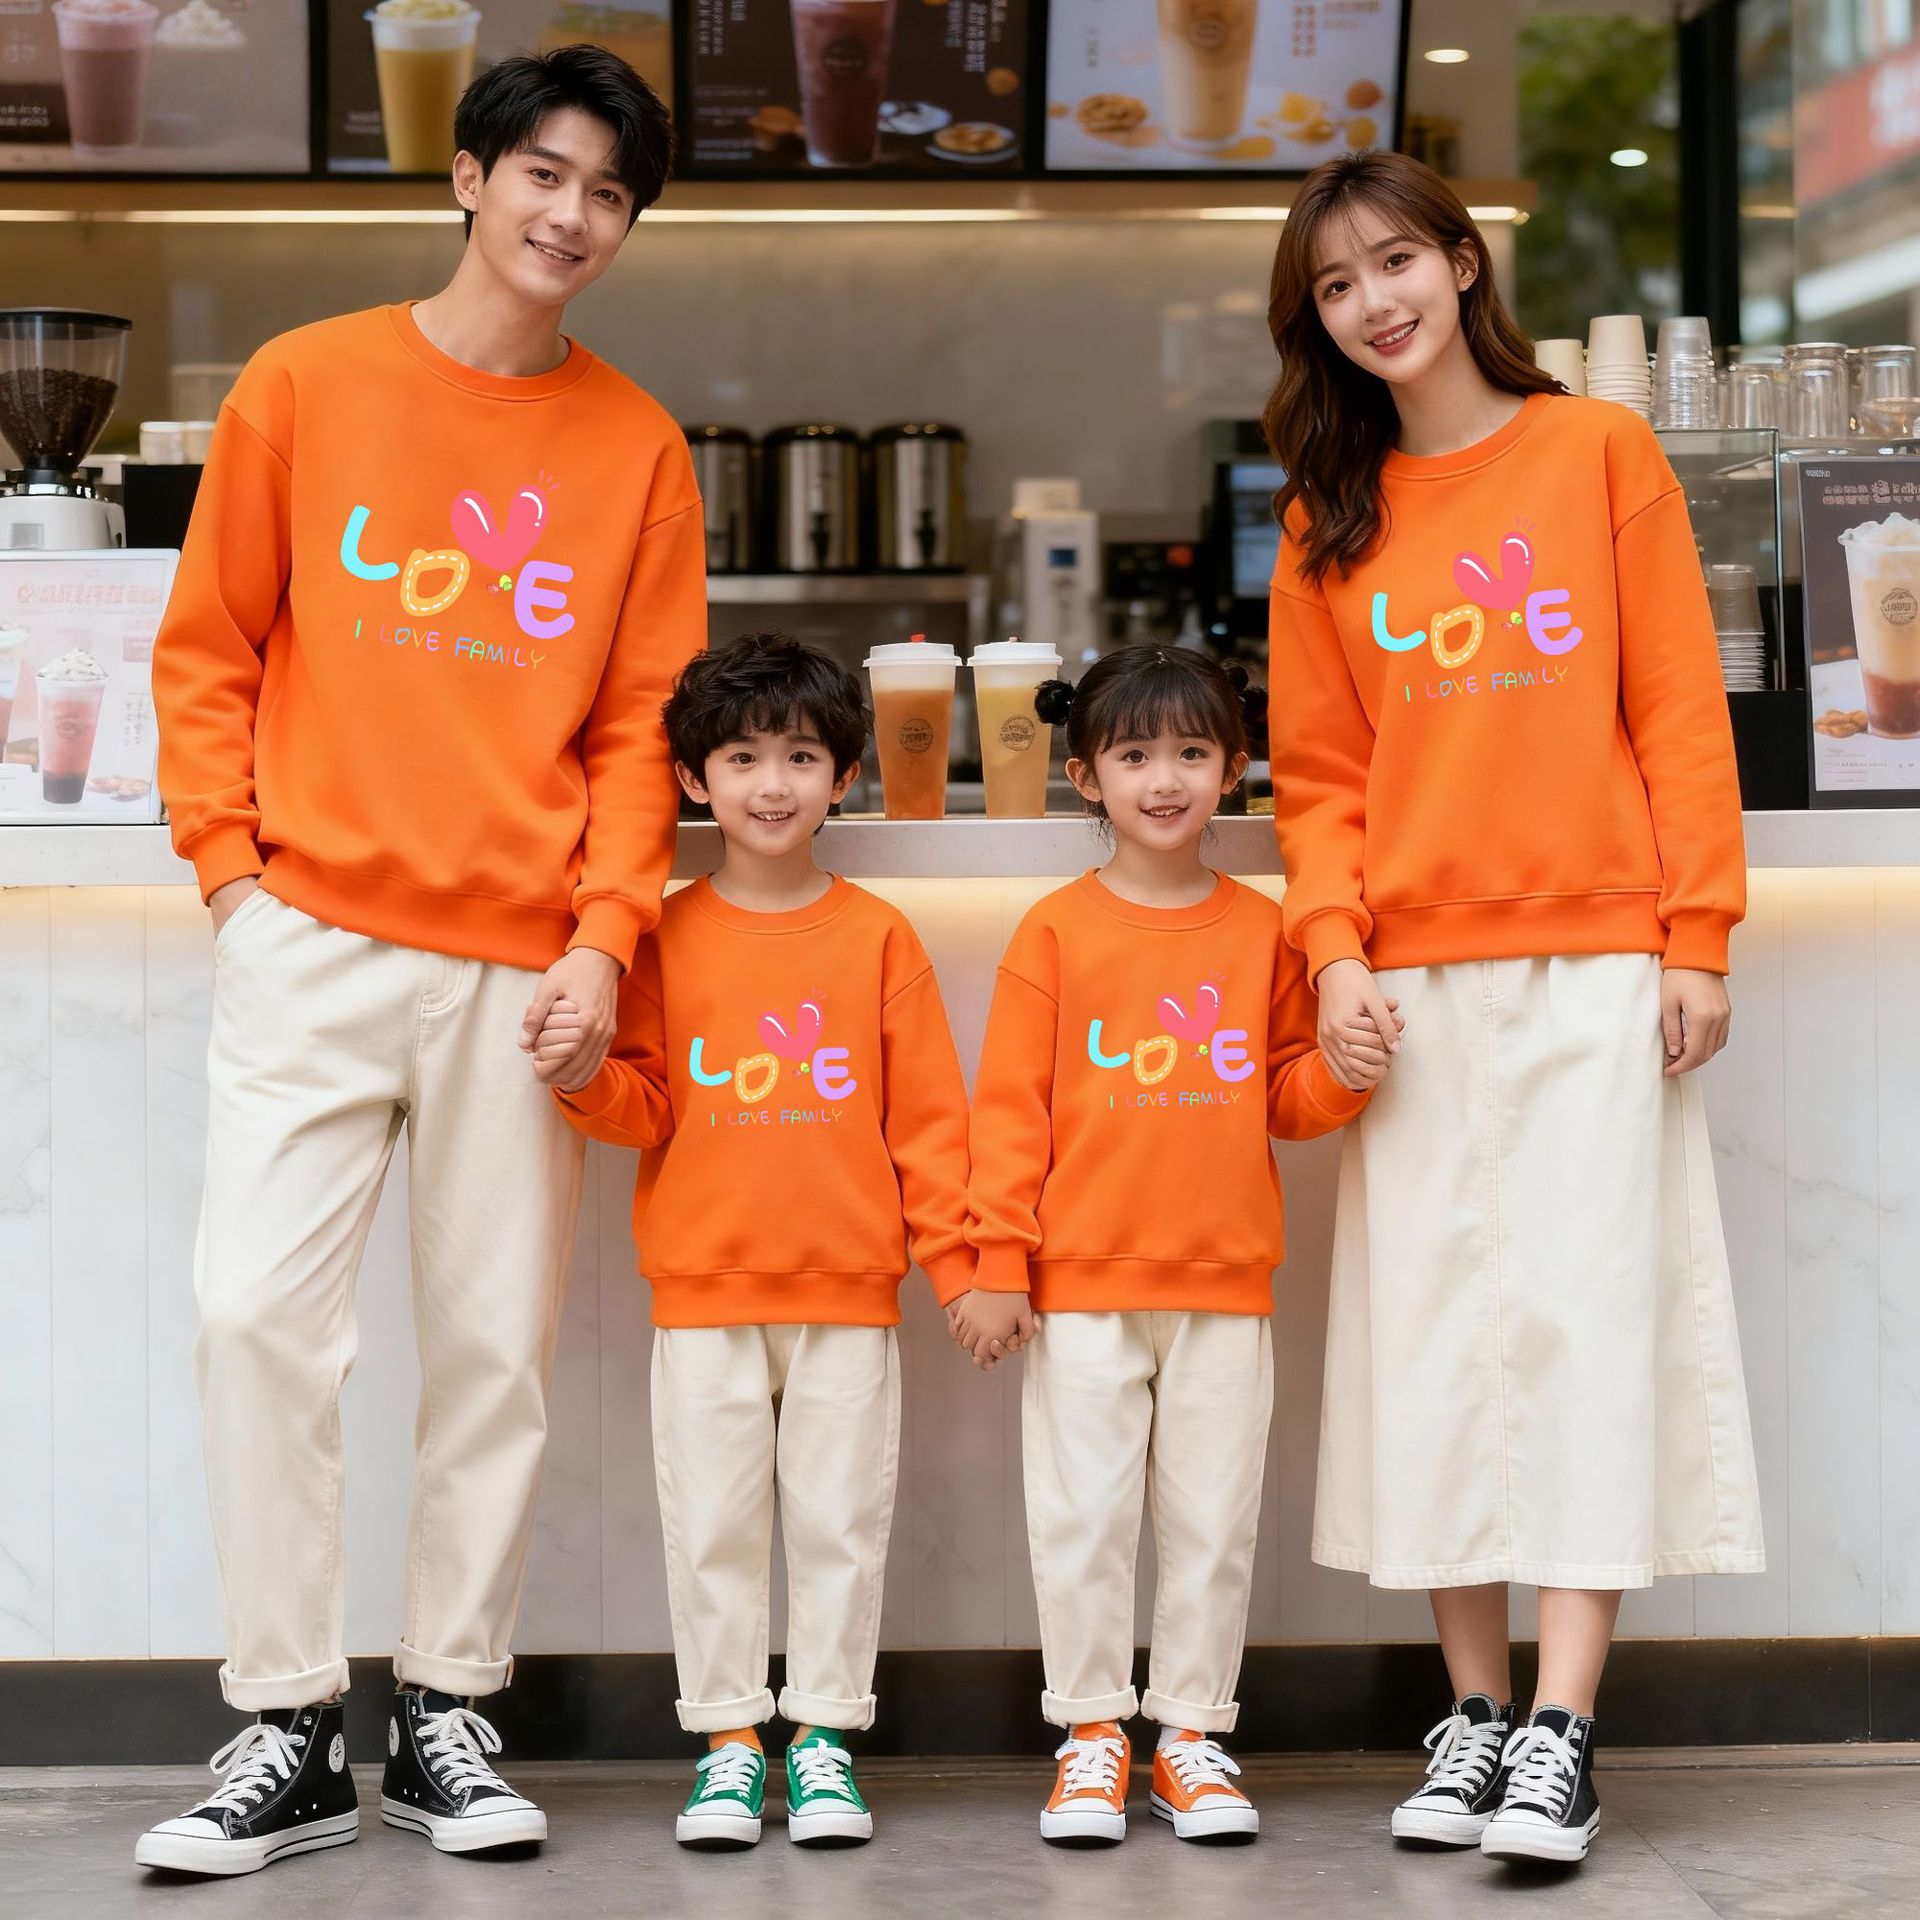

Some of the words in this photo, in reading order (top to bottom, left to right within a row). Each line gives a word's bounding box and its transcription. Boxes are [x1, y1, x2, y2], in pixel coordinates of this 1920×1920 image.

[340, 486, 576, 639] LOVE
[1372, 531, 1583, 669] LOVE
[379, 624, 440, 651] LOVE
[454, 636, 546, 670] FAMILY
[1425, 676, 1479, 698] LOVE
[1491, 665, 1569, 692] FAMILY
[689, 1000, 857, 1104] LOVE
[1087, 982, 1256, 1086] LOVE
[728, 1110, 770, 1126] LOVE
[780, 1108, 843, 1125] FAMILY
[1126, 1092, 1169, 1107] LOVE
[1178, 1090, 1240, 1105] FAMILY
